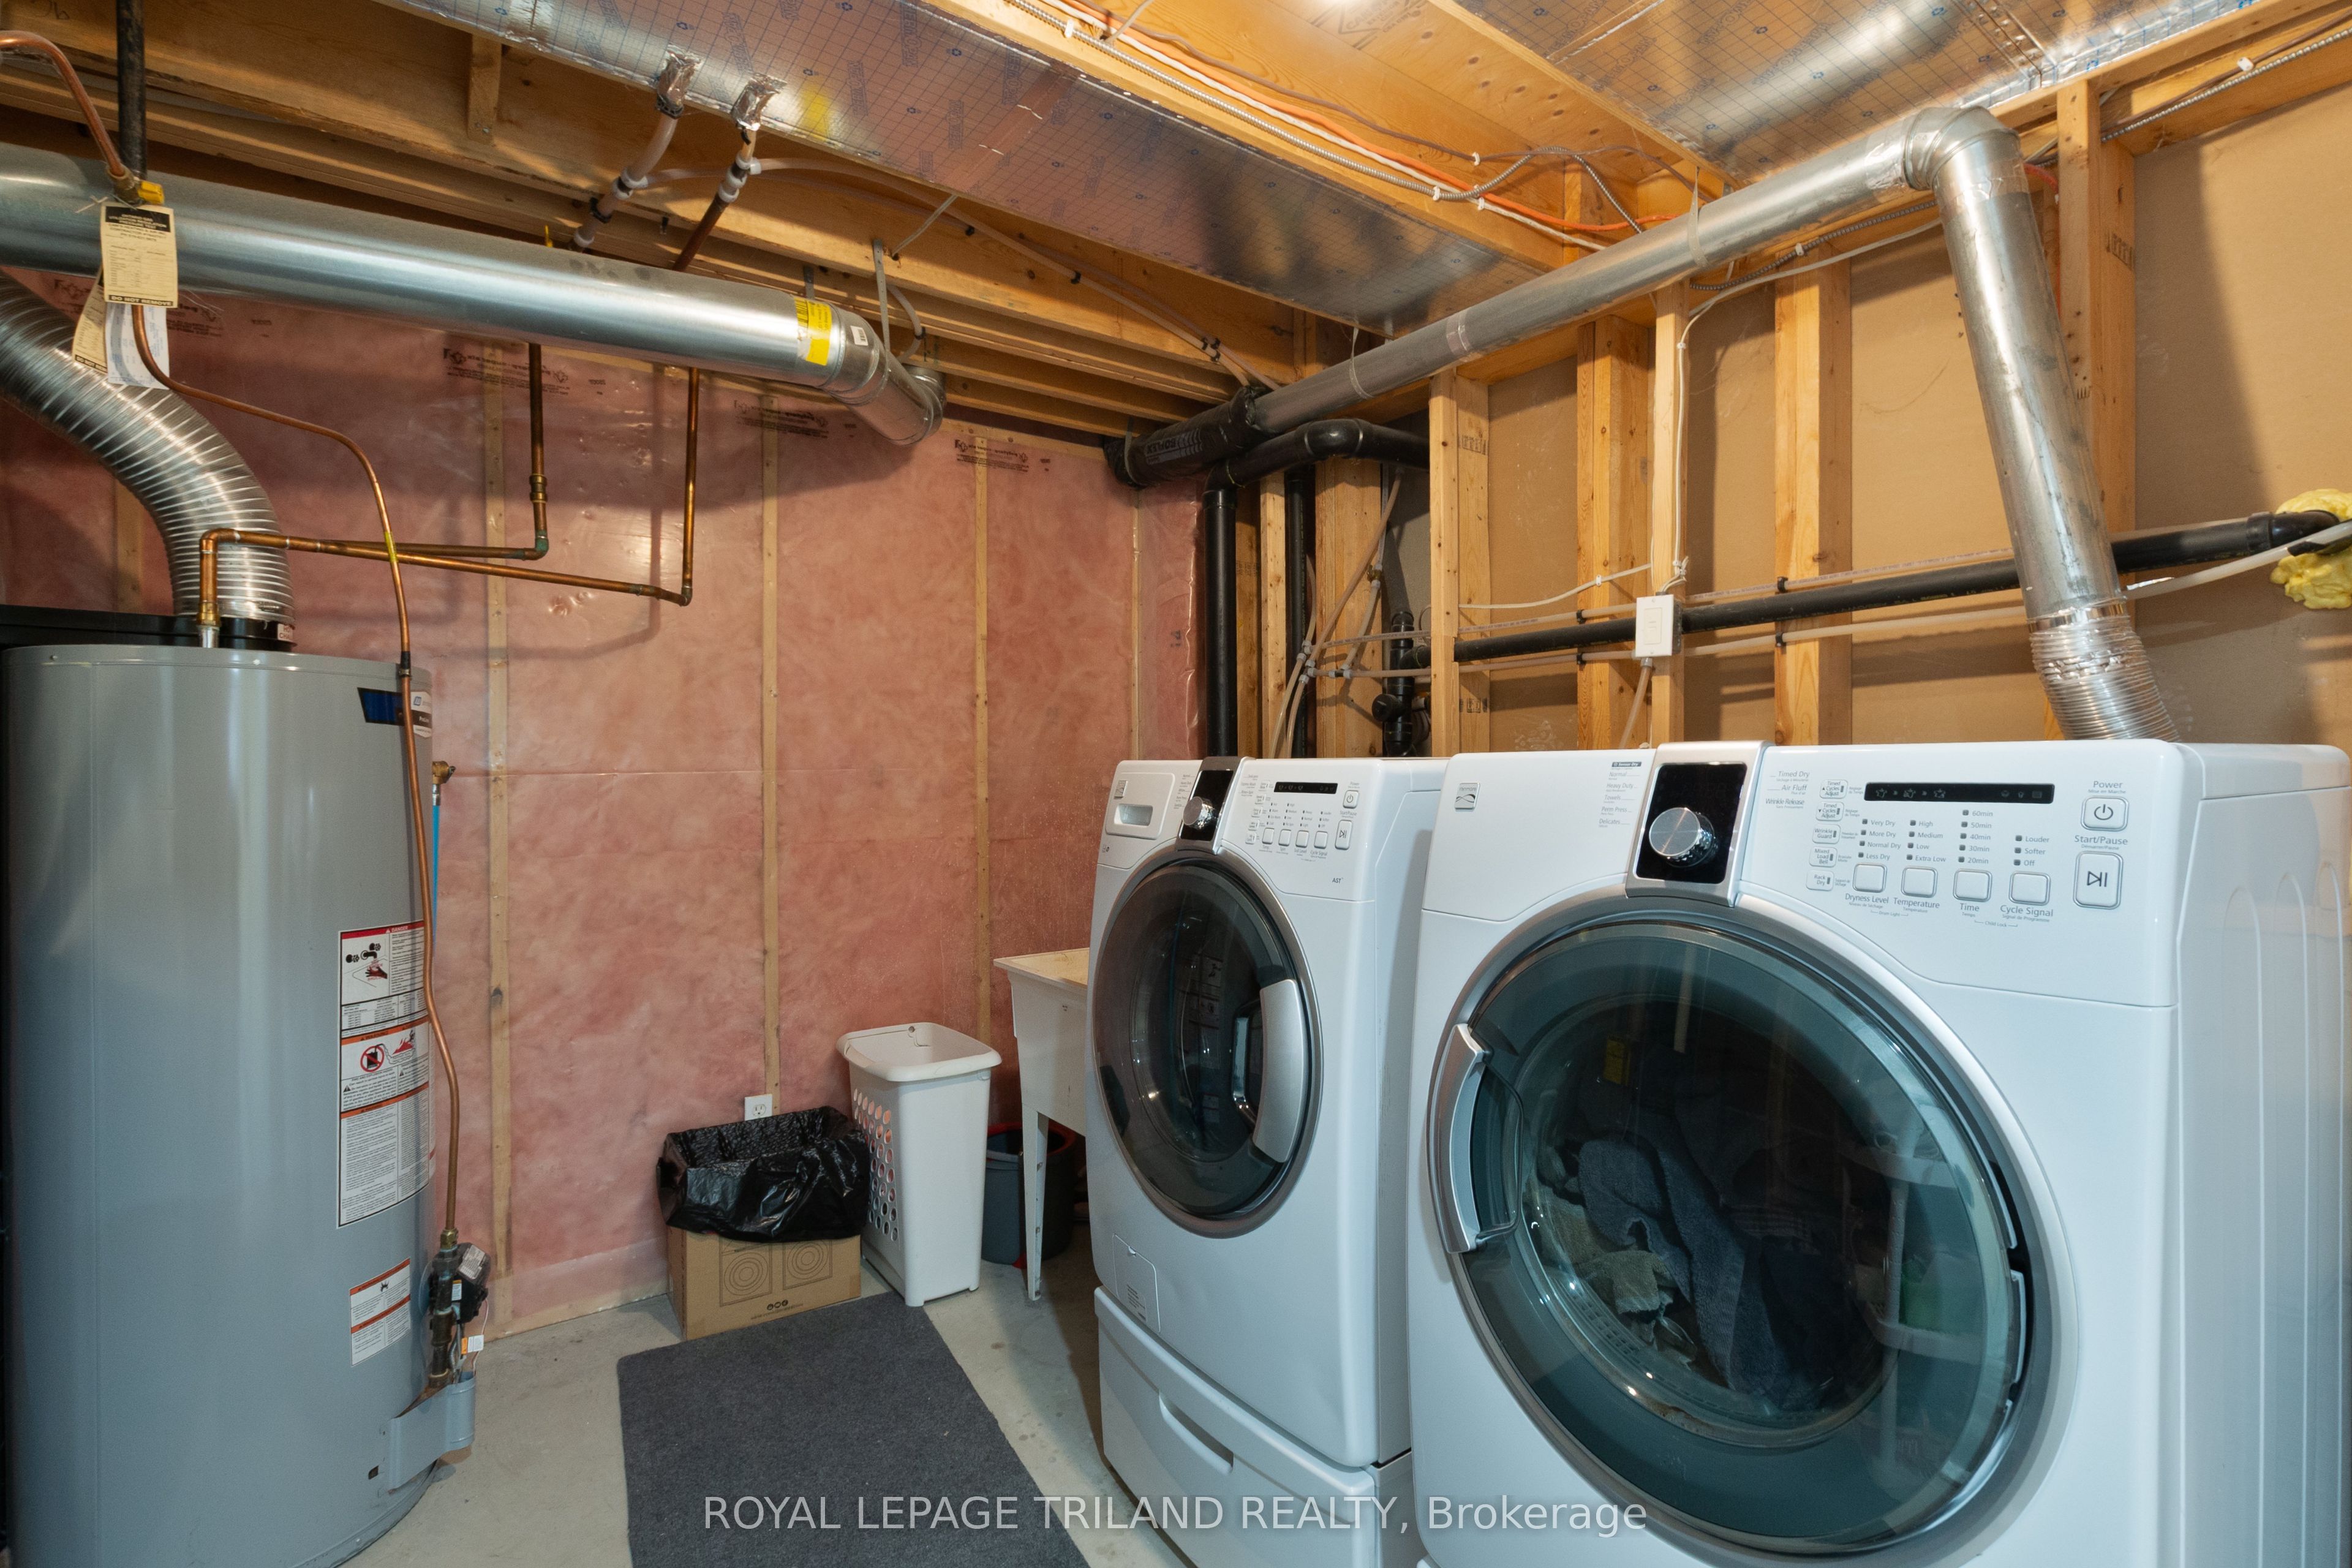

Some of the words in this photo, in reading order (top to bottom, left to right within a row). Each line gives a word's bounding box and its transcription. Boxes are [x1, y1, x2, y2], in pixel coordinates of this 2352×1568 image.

[1799, 771, 1810, 780] Dry
[2075, 835, 2128, 845] Start/Pause
[1845, 893, 1870, 902] Dryness
[1893, 897, 1940, 908] Temperature
[1960, 903, 1980, 911] Time
[2000, 905, 2023, 914] Cycle
[2026, 907, 2054, 917] Signal
